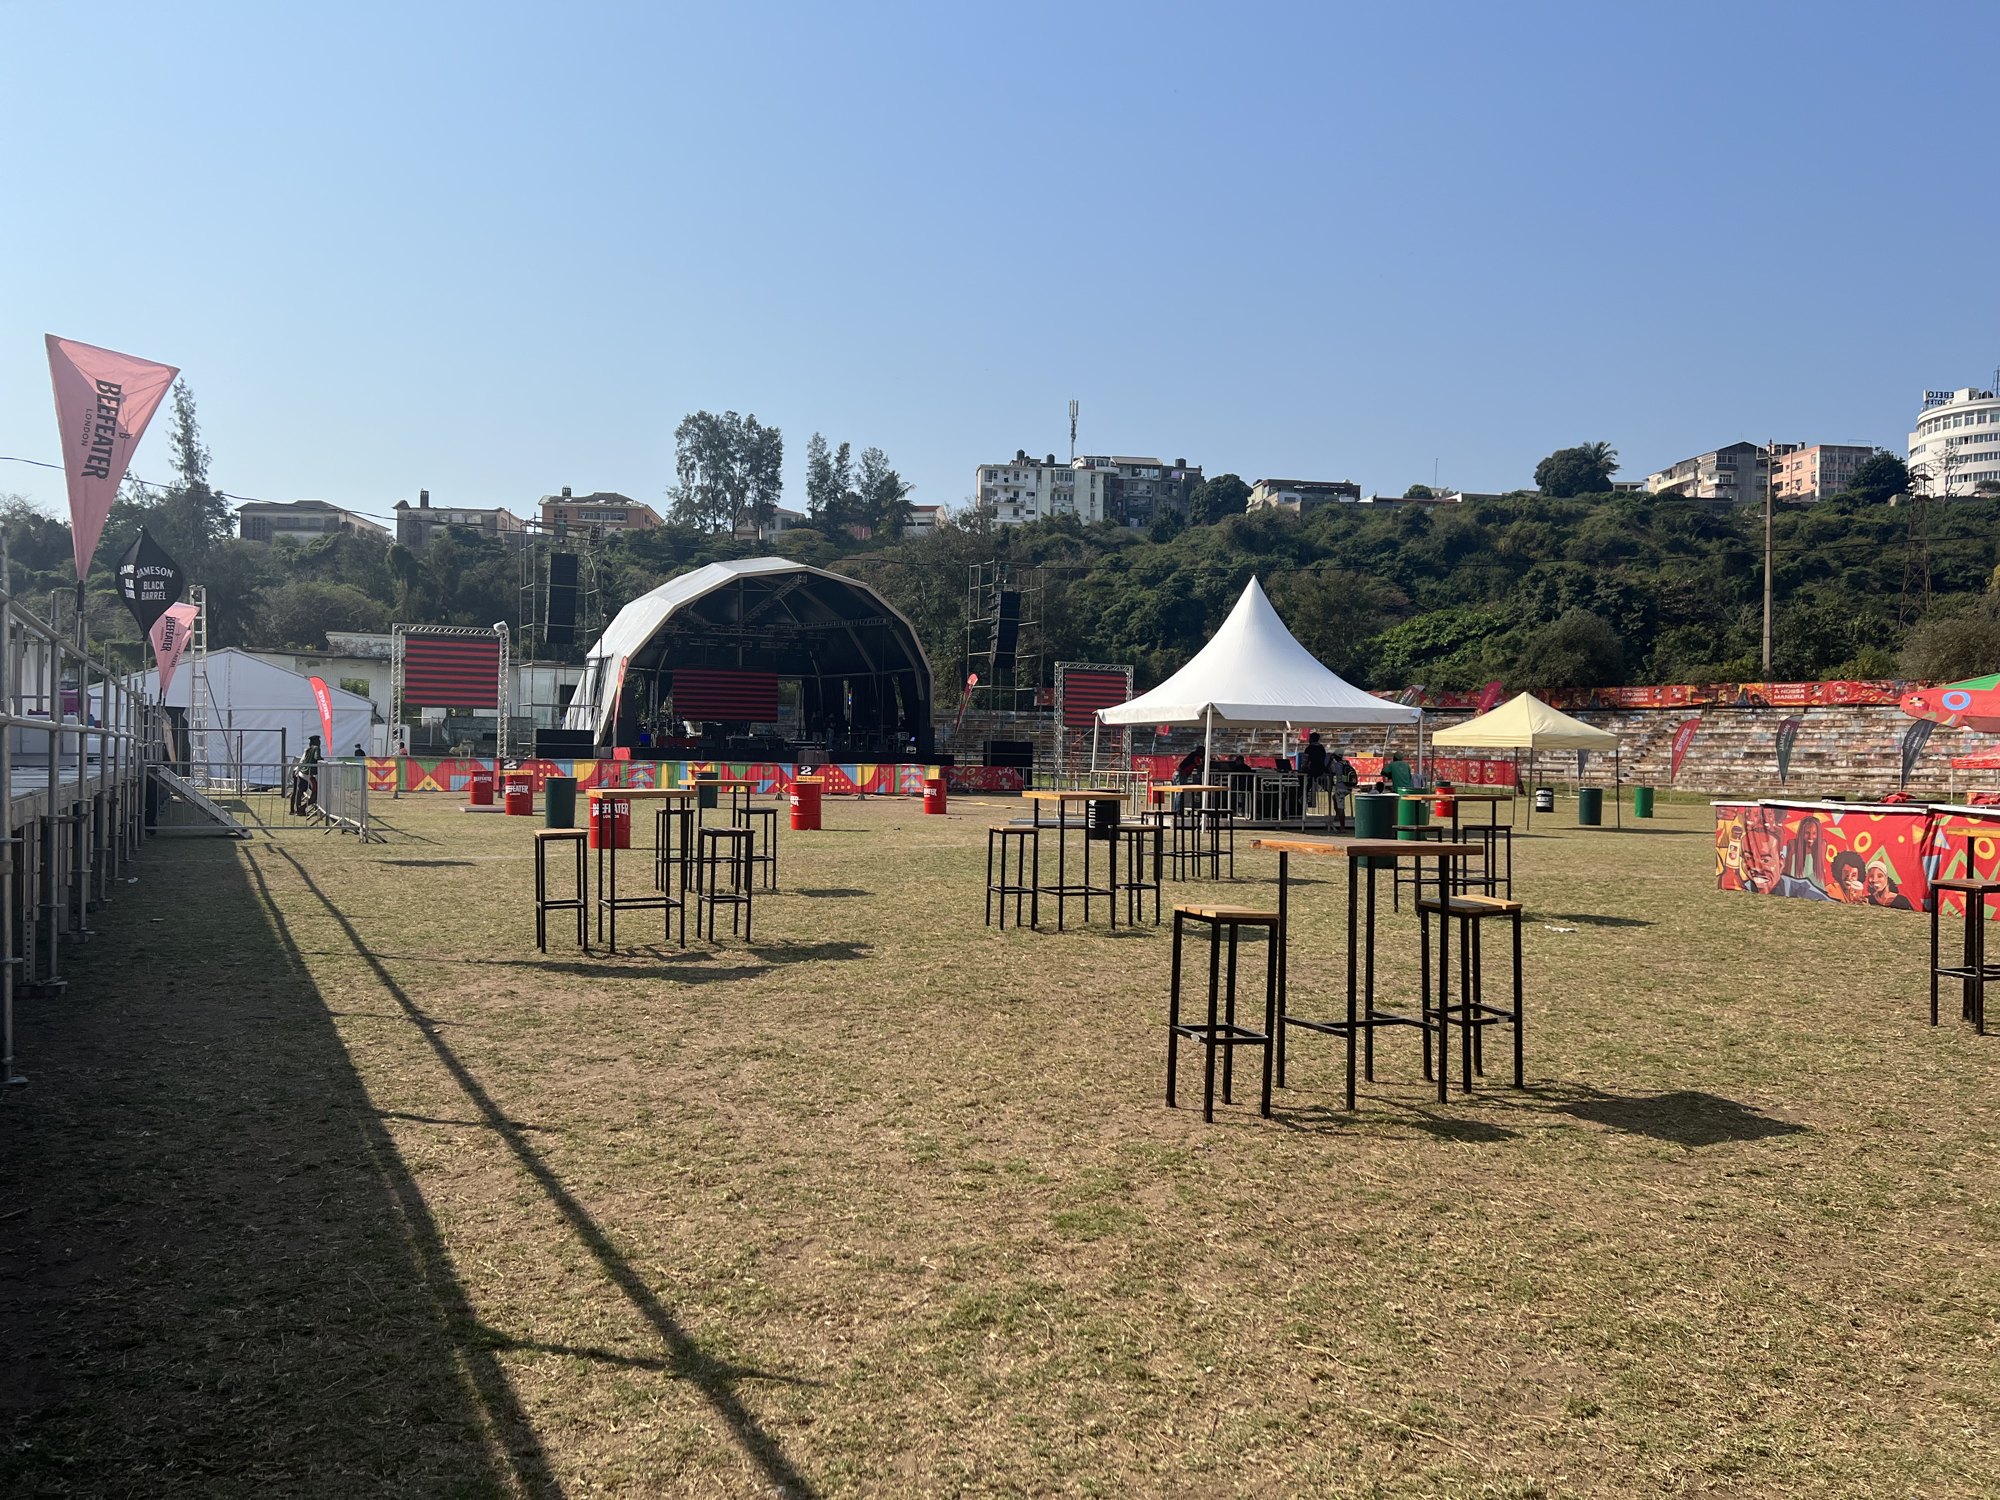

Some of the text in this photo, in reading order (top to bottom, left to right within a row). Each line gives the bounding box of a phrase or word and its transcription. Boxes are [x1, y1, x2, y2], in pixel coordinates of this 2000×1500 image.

[81, 408, 93, 446] LONDON
[81, 379, 121, 480] BEEFEATER
[136, 566, 174, 578] JAMESON
[142, 592, 166, 600] BARREL
[144, 580, 164, 590] BLACK
[161, 616, 176, 652] BEEFEATER
